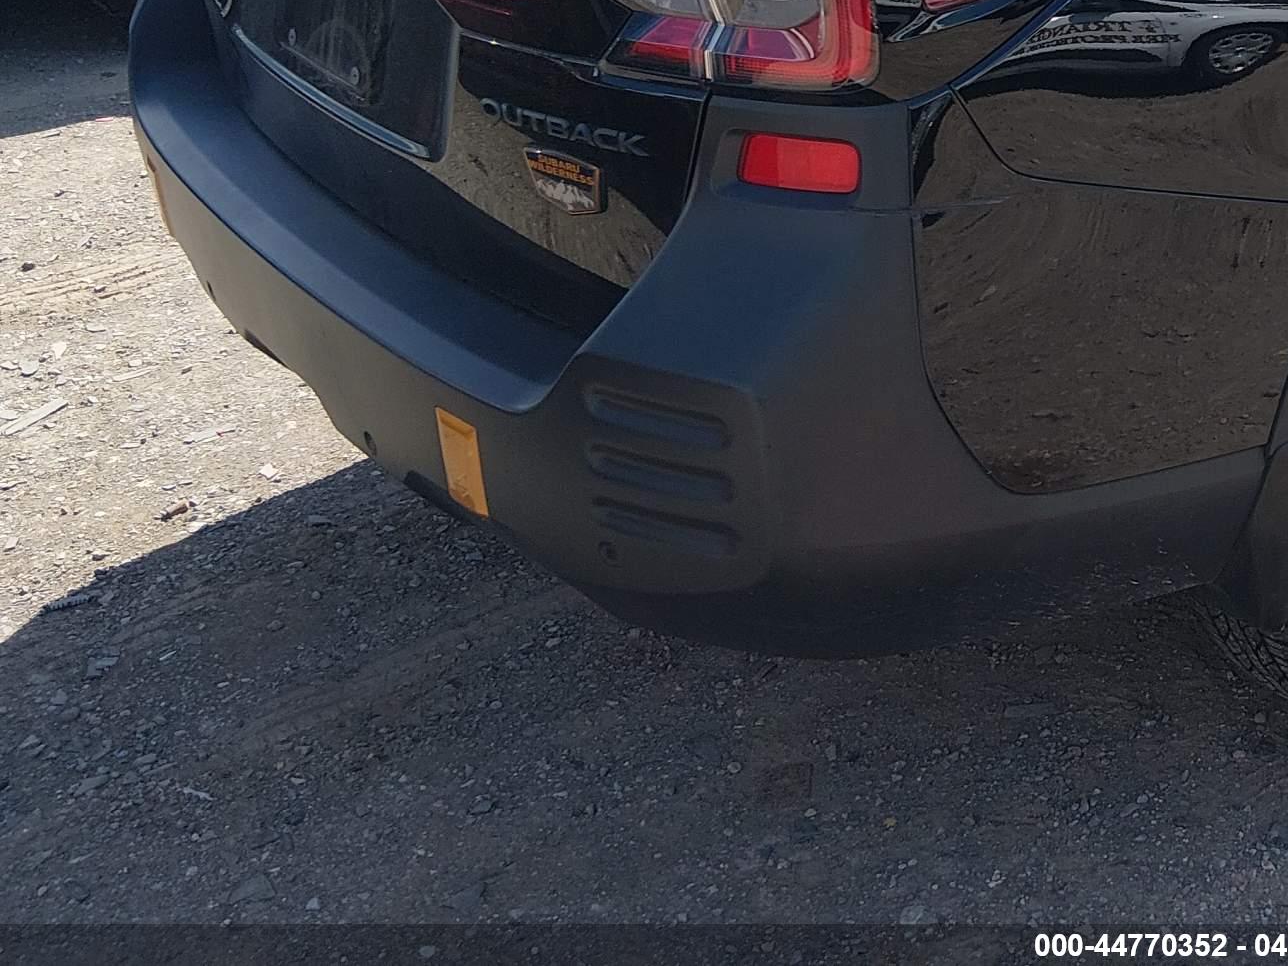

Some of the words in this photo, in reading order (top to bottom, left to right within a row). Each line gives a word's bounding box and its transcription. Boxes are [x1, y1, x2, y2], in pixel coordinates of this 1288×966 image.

[479, 97, 650, 157] OUTBACK
[527, 158, 594, 185] WILDERNESS
[537, 153, 581, 173] SUBARU
